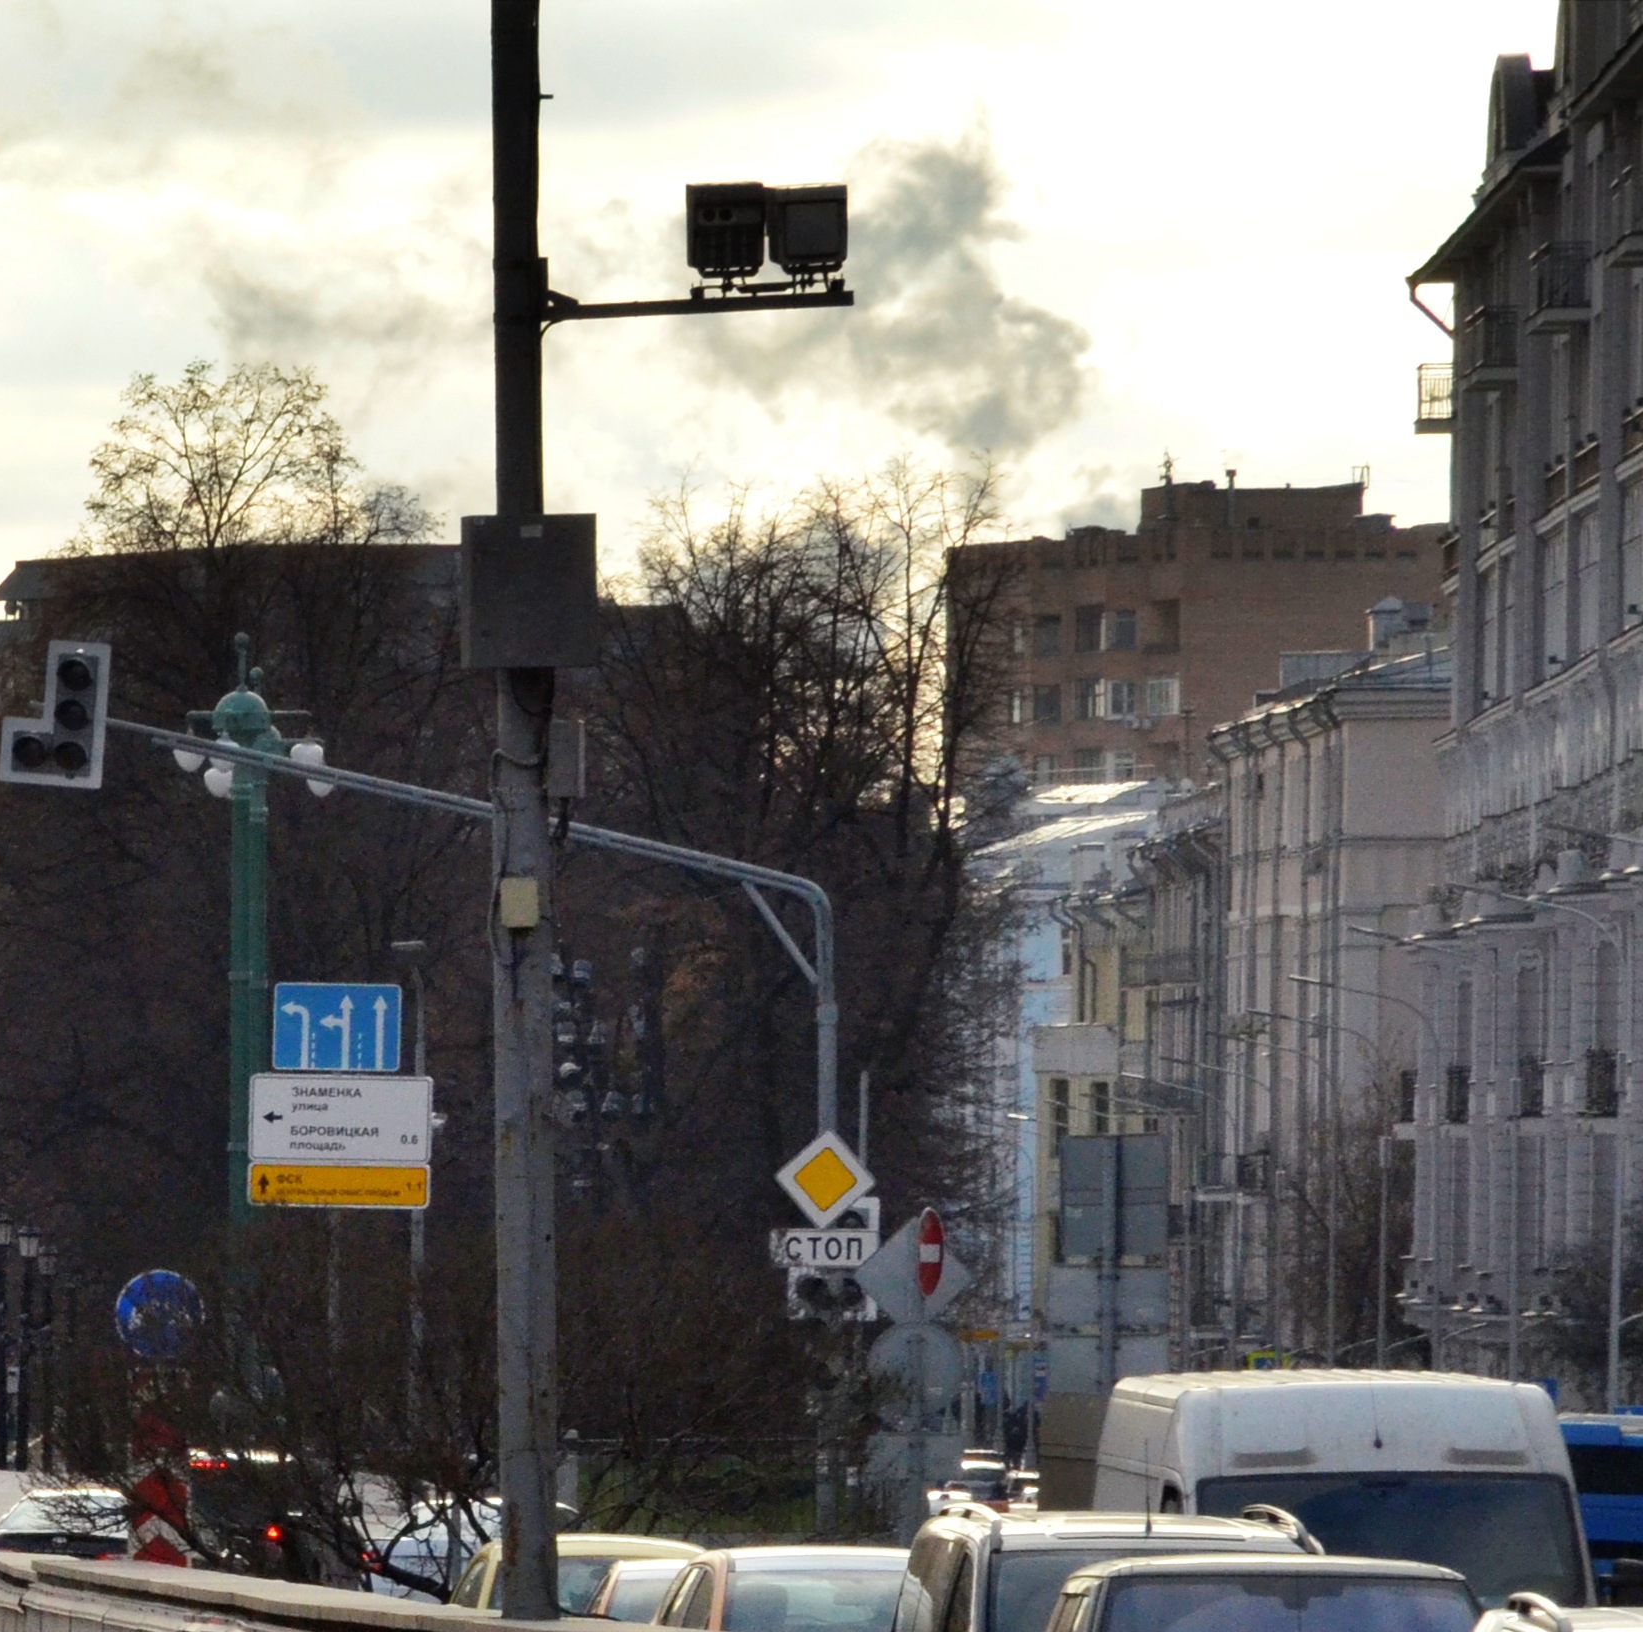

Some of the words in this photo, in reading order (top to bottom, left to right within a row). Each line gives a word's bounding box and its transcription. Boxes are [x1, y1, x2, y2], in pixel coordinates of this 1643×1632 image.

[292, 1086, 362, 1098] ЗНАМЕНКА
[292, 1102, 329, 1113] улица
[290, 1125, 379, 1138] БОРОВИЦКАЯ
[400, 1134, 419, 1145] 0.6
[289, 1141, 346, 1152] площадь
[785, 1236, 862, 1261] СТОП
